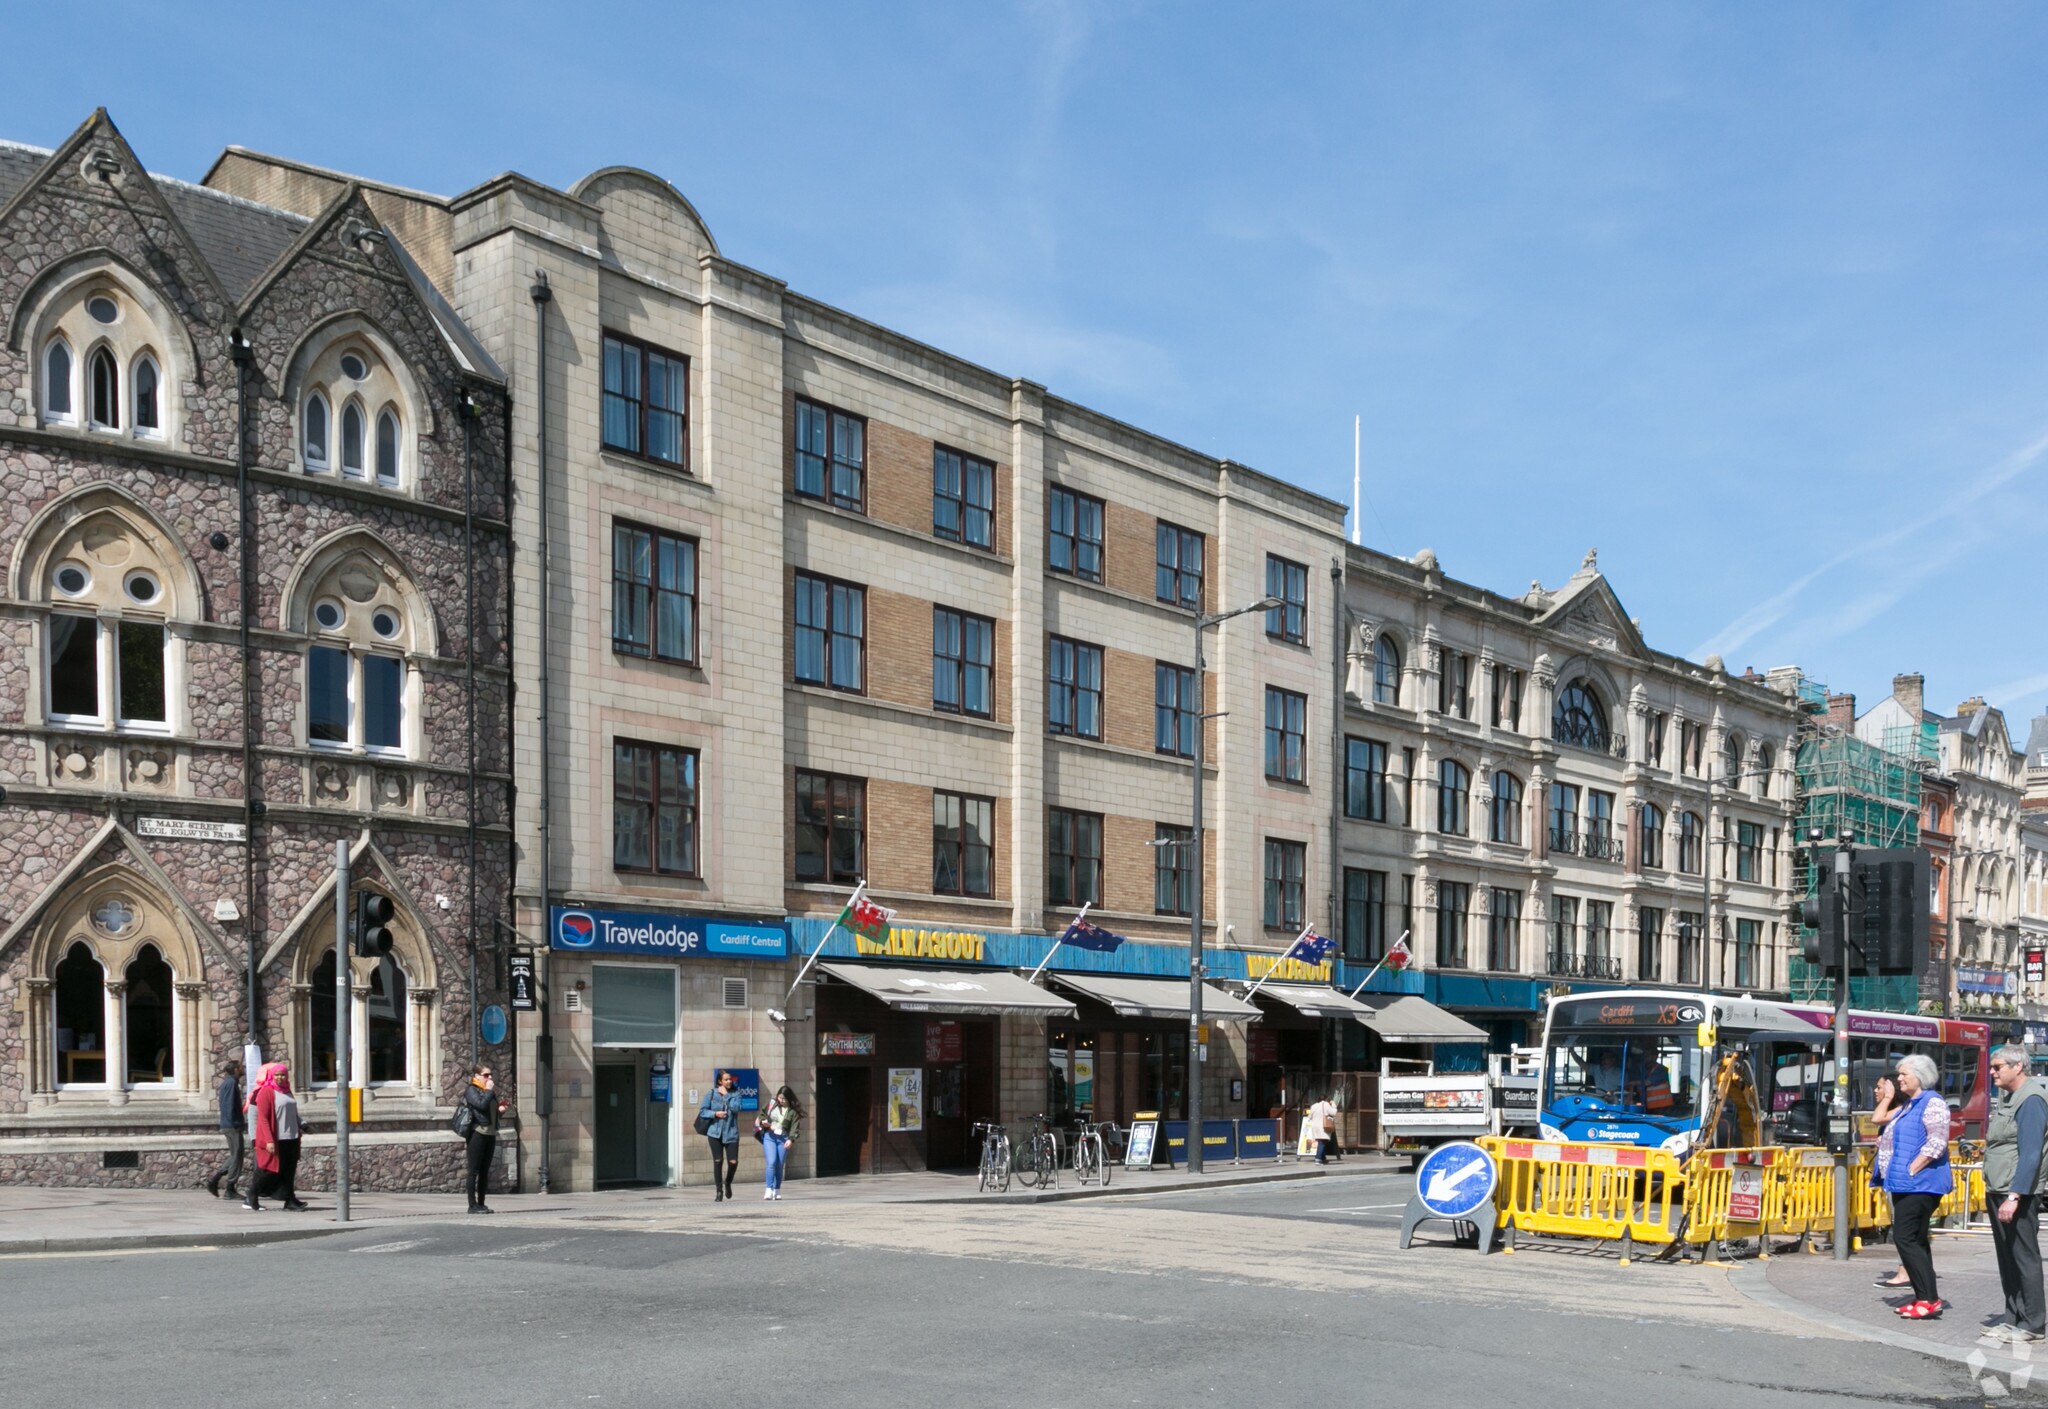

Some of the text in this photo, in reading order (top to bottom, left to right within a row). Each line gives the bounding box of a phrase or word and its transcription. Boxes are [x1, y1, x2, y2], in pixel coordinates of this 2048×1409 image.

[140, 819, 225, 831] ST MARY STREET
[141, 826, 234, 839] HEOL EGLWYS FAIR
[600, 919, 782, 952] Travelodge Cardiff Central
[855, 927, 986, 961] WALKABOUT
[2027, 962, 2043, 971] BAR
[2027, 973, 2043, 982] BBQ
[1601, 1004, 1634, 1017] Cardiff
[1657, 1004, 1678, 1025] X3
[1851, 1018, 1932, 1036] Cwmbran Pontypool Abergavenny Hereford
[828, 1040, 873, 1050] RHYTHM ROOM
[1383, 1092, 1411, 1100] Guardian
[1504, 1091, 1538, 1102] Guardian Ga
[1133, 1127, 1152, 1139] FINAL
[1245, 1134, 1271, 1143] WALKABOUT
[1598, 1129, 1640, 1140] Stagecoach
[1168, 1137, 1185, 1147] ABOUT
[1203, 1136, 1227, 1145] WALKABOUT
